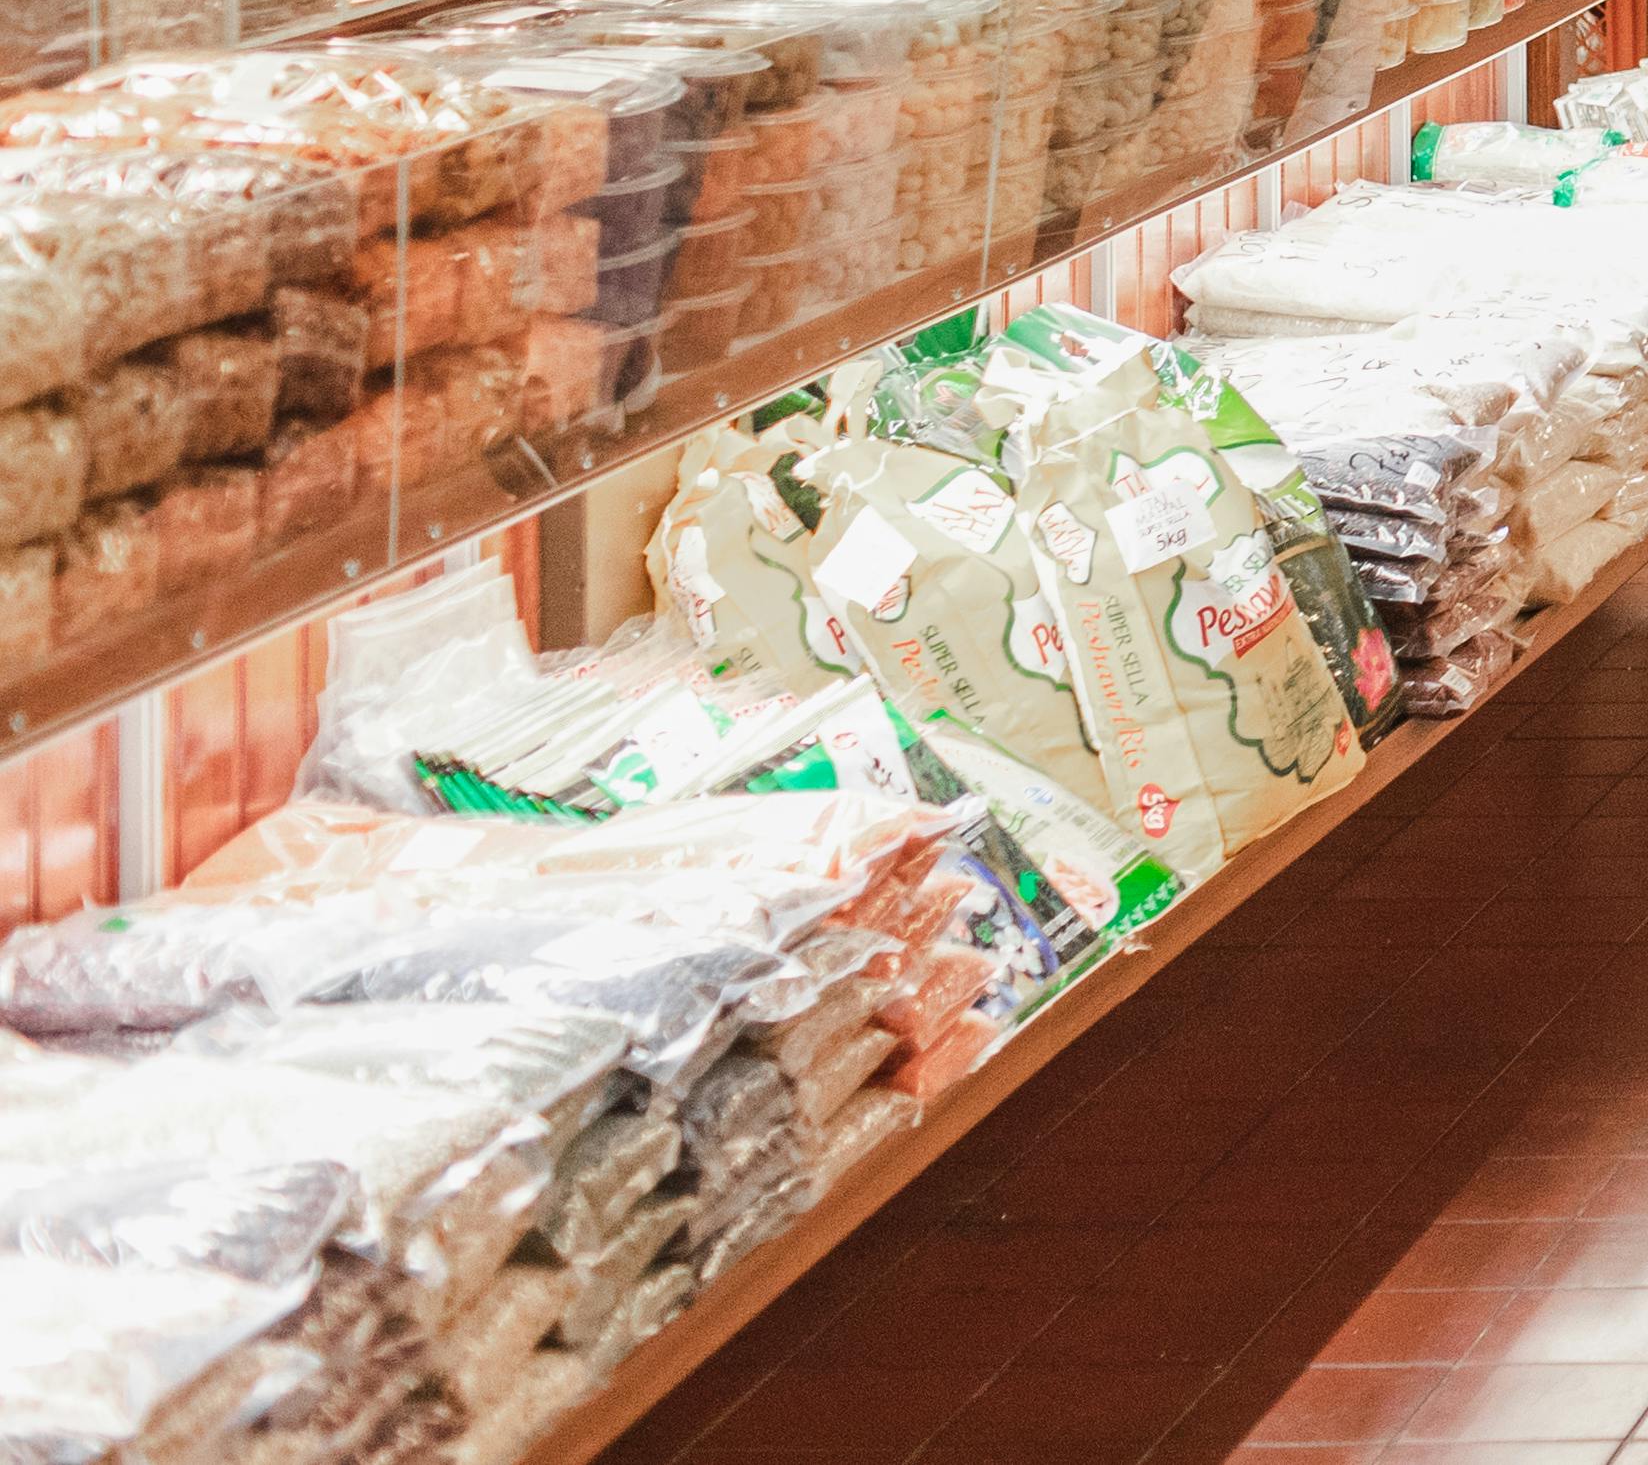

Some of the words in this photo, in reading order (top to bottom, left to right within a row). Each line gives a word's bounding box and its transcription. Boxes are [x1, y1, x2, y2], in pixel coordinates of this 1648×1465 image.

[920, 622, 959, 682] SUPER
[1104, 593, 1133, 651] SUPER
[1120, 650, 1150, 707] SELLA
